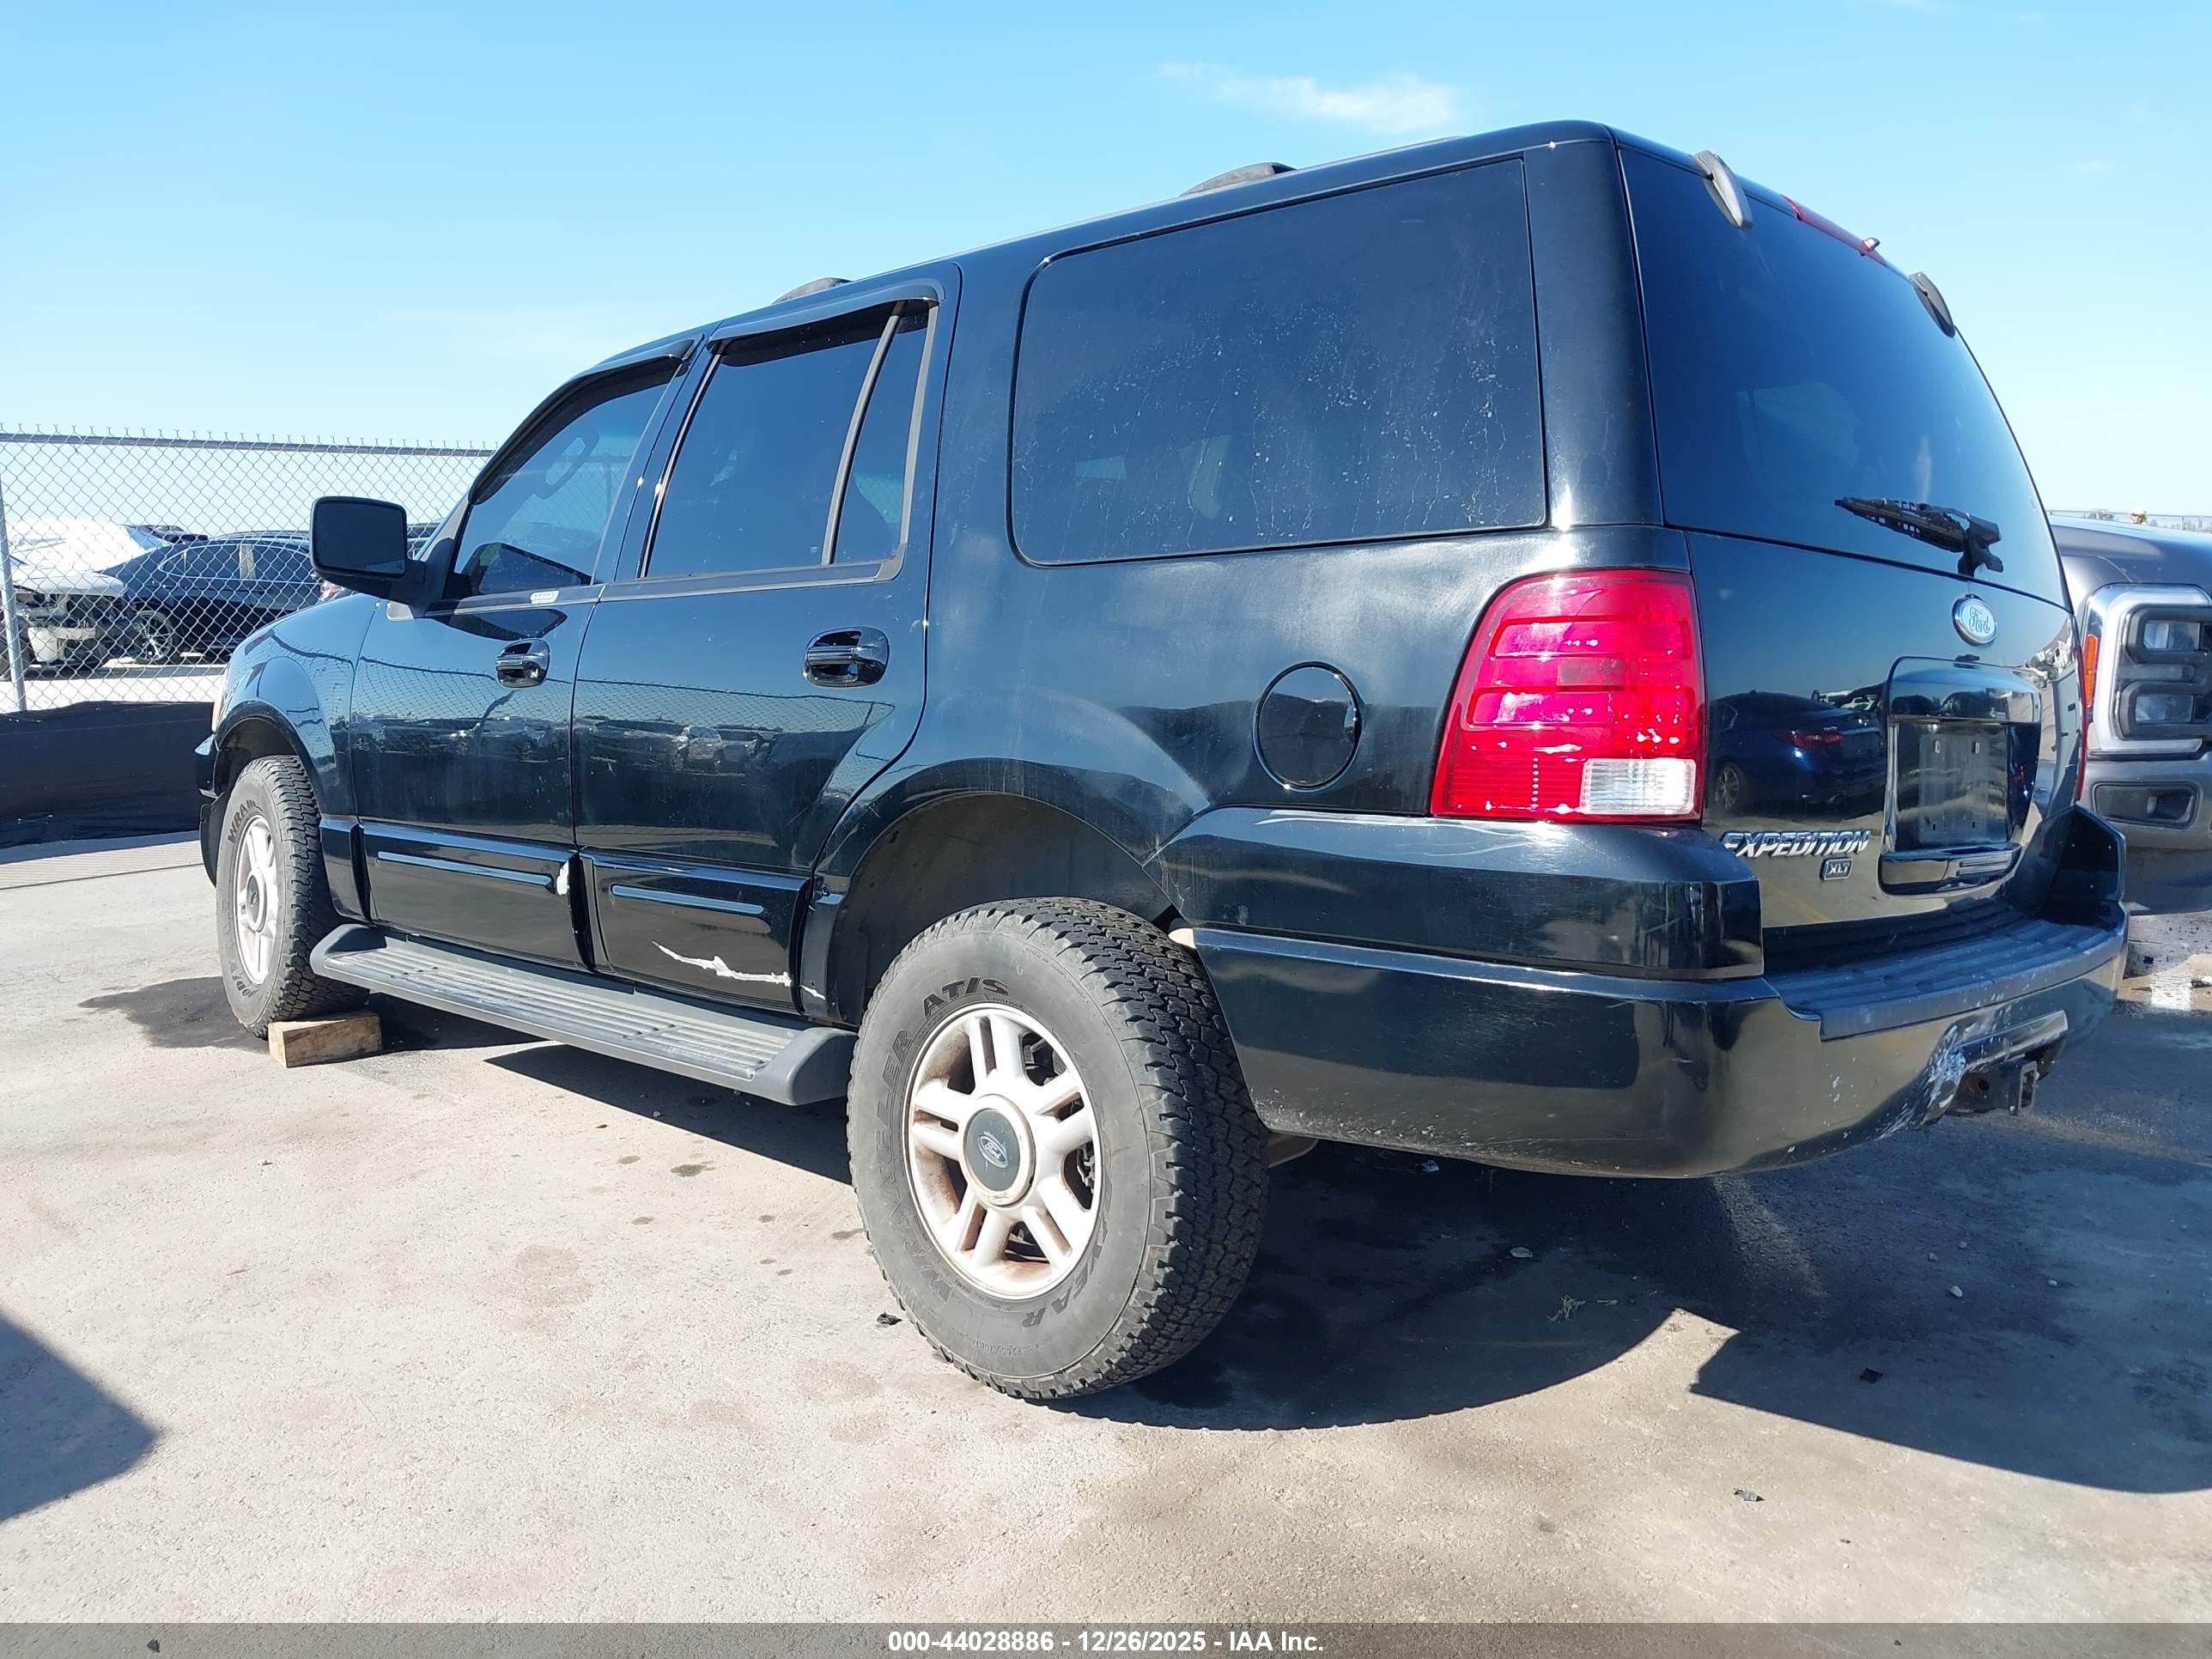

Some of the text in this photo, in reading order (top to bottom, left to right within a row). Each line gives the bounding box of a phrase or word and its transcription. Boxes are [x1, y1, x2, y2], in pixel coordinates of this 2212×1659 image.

[1722, 830, 1871, 858] EXPEDITION
[1826, 861, 1851, 876] XLT
[922, 975, 1009, 1018] AT/S
